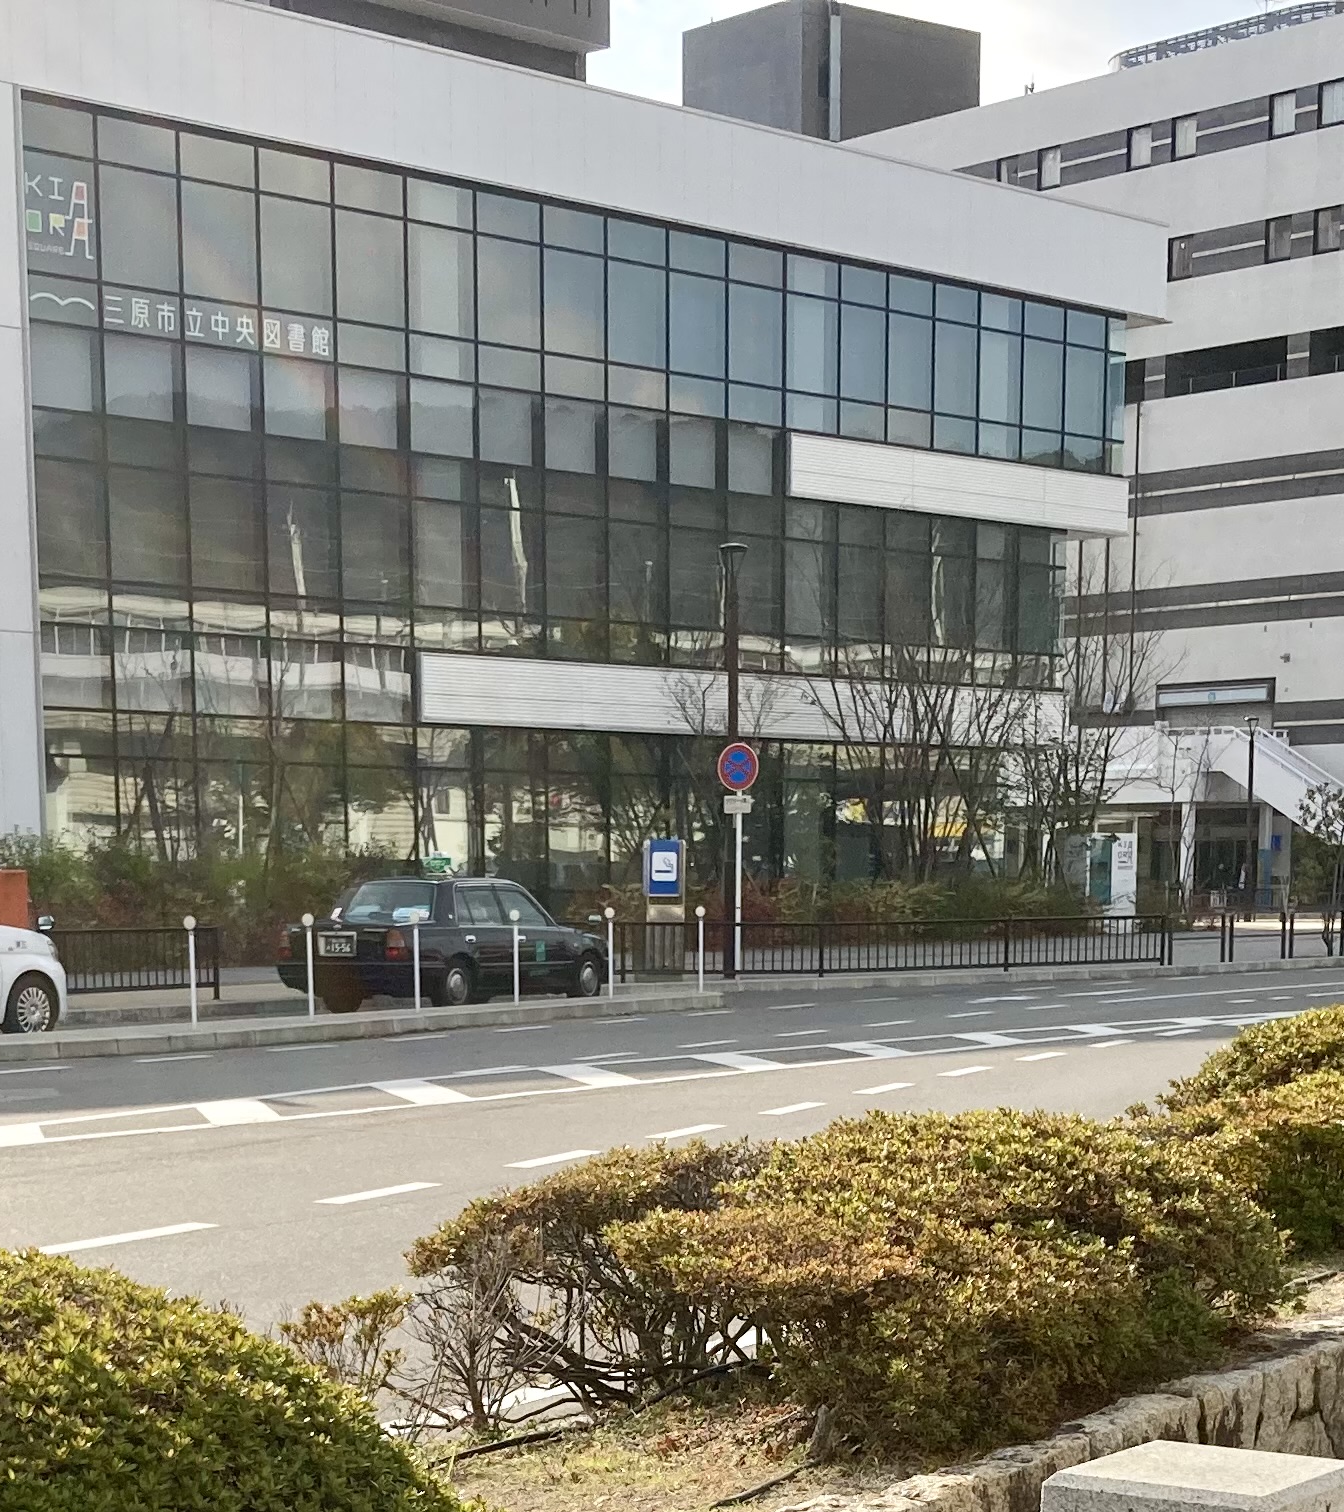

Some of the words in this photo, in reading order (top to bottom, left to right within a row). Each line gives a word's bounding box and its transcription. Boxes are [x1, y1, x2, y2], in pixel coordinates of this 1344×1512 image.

[103, 294, 330, 357] 三原市立中央図書館
